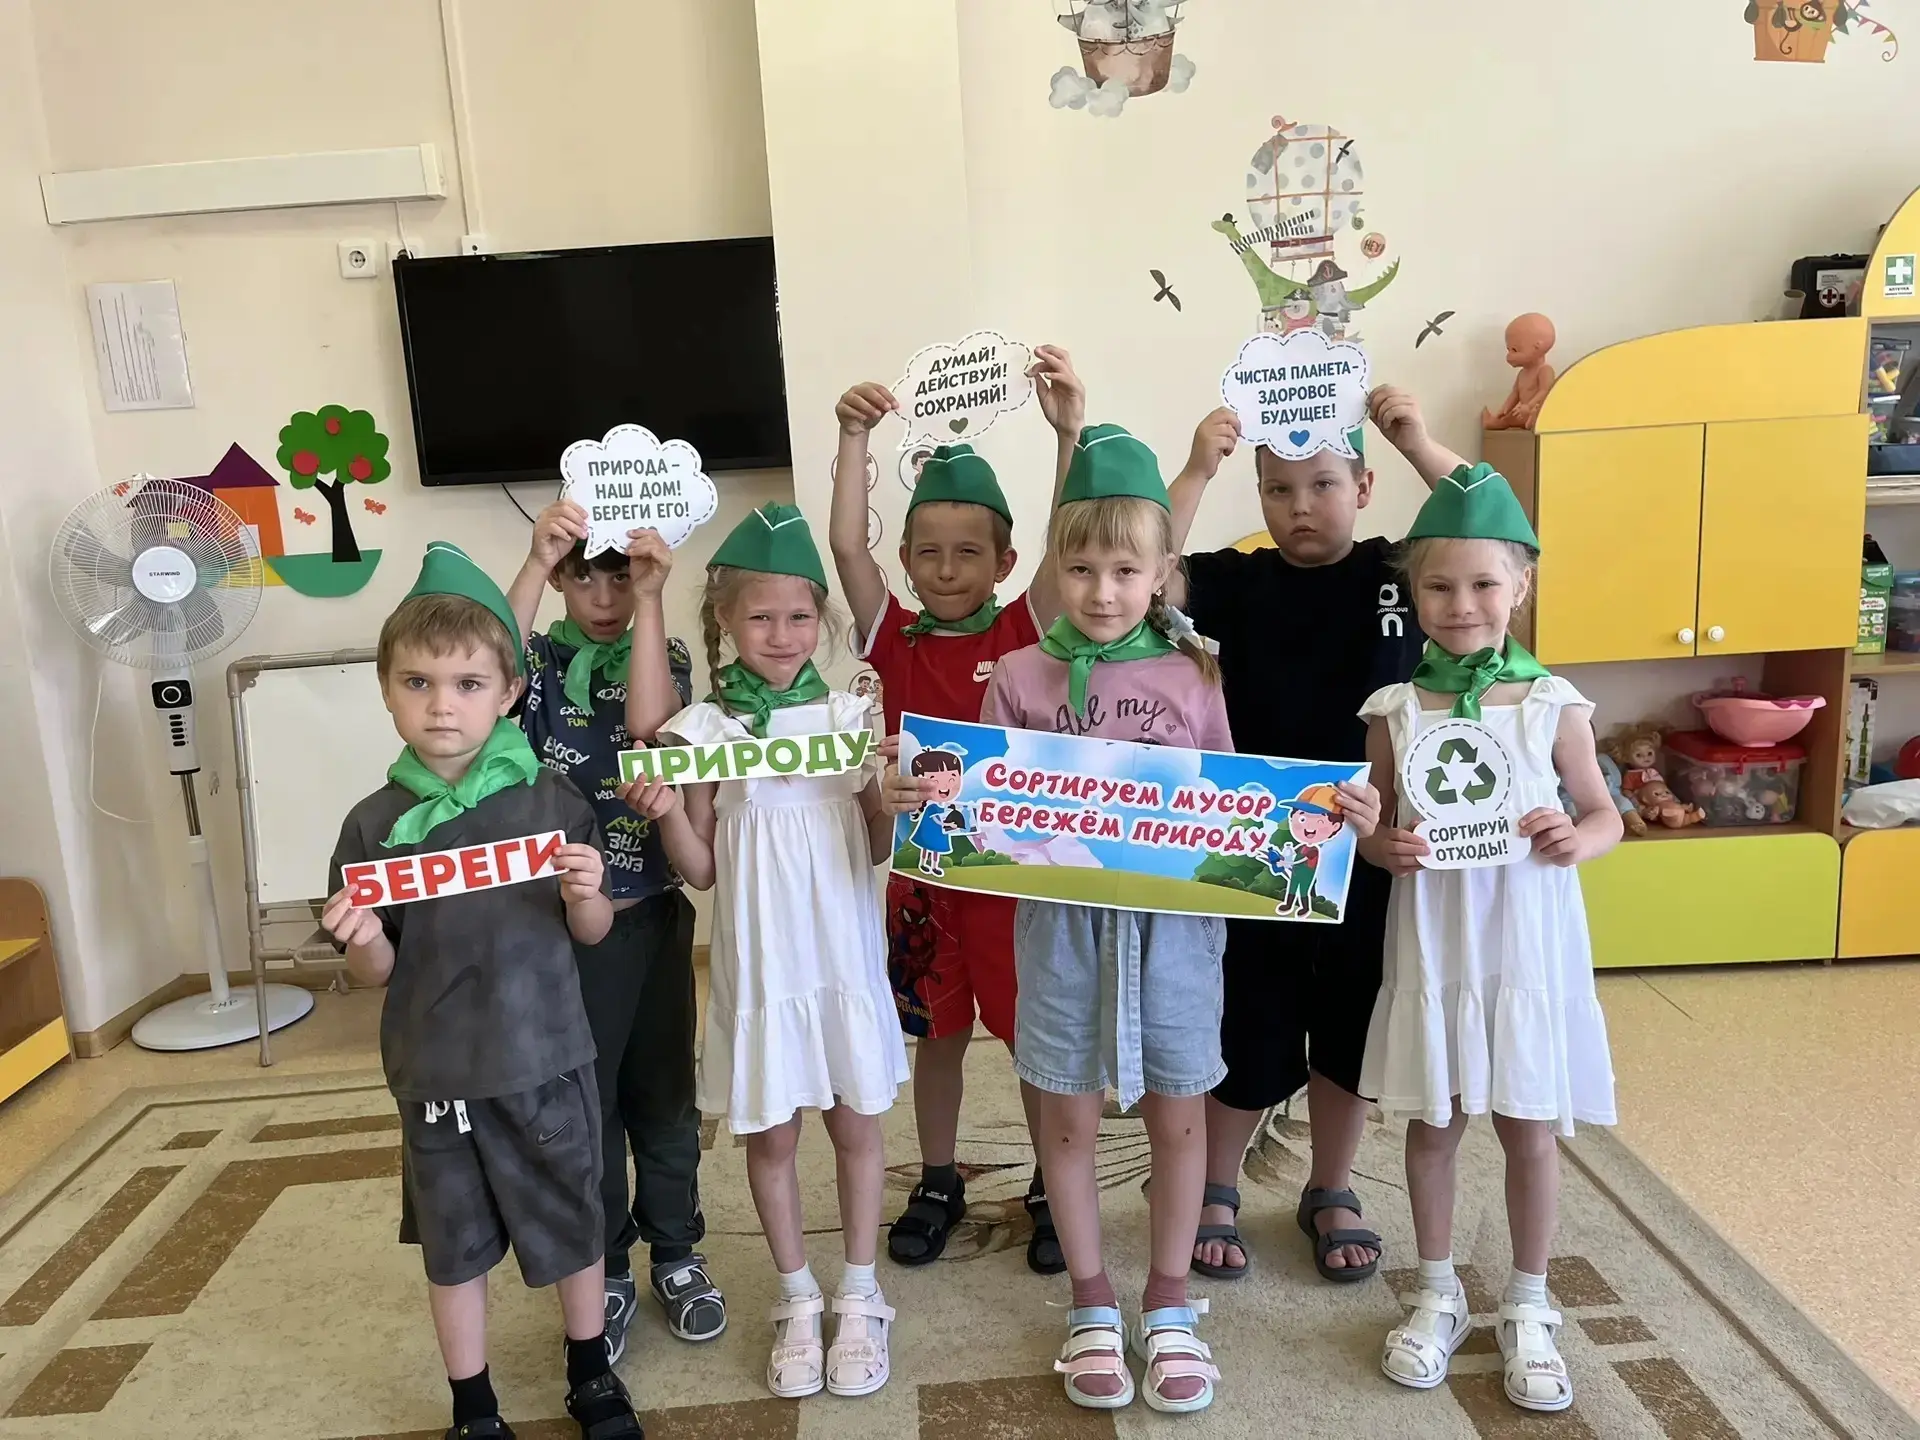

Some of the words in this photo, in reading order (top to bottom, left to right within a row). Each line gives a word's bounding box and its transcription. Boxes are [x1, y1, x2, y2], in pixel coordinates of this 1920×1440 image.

[929, 346, 996, 375] ДУМАЙ!
[915, 363, 1007, 397] ДЕЙСТВУЙ!
[1235, 367, 1286, 385] ЧИСТАЯ
[914, 384, 1007, 418] СОХРАНЯЙ!
[1258, 383, 1336, 406] ЗДОРОВОЕ
[1261, 403, 1336, 426] БУДУЩЕЕ!
[588, 459, 668, 477] ПРИРОДА
[595, 483, 633, 499] НАШ
[640, 480, 681, 498] ДОМ!
[592, 504, 651, 521] БЕРЕГИ
[657, 501, 690, 518] ЕГО!
[977, 661, 997, 673] NIK
[567, 717, 588, 728] FUN
[1117, 698, 1166, 732] my
[543, 736, 590, 765] ENJOY
[620, 730, 872, 785] ПРИРОДУ
[605, 816, 650, 837] DAY
[1429, 816, 1509, 843] СОРТИРУЙ
[607, 832, 642, 851] THE
[1436, 839, 1508, 861] ОТХОДЫ!
[345, 833, 566, 907] БЕРЕГИ
[605, 851, 644, 872] ENJO
